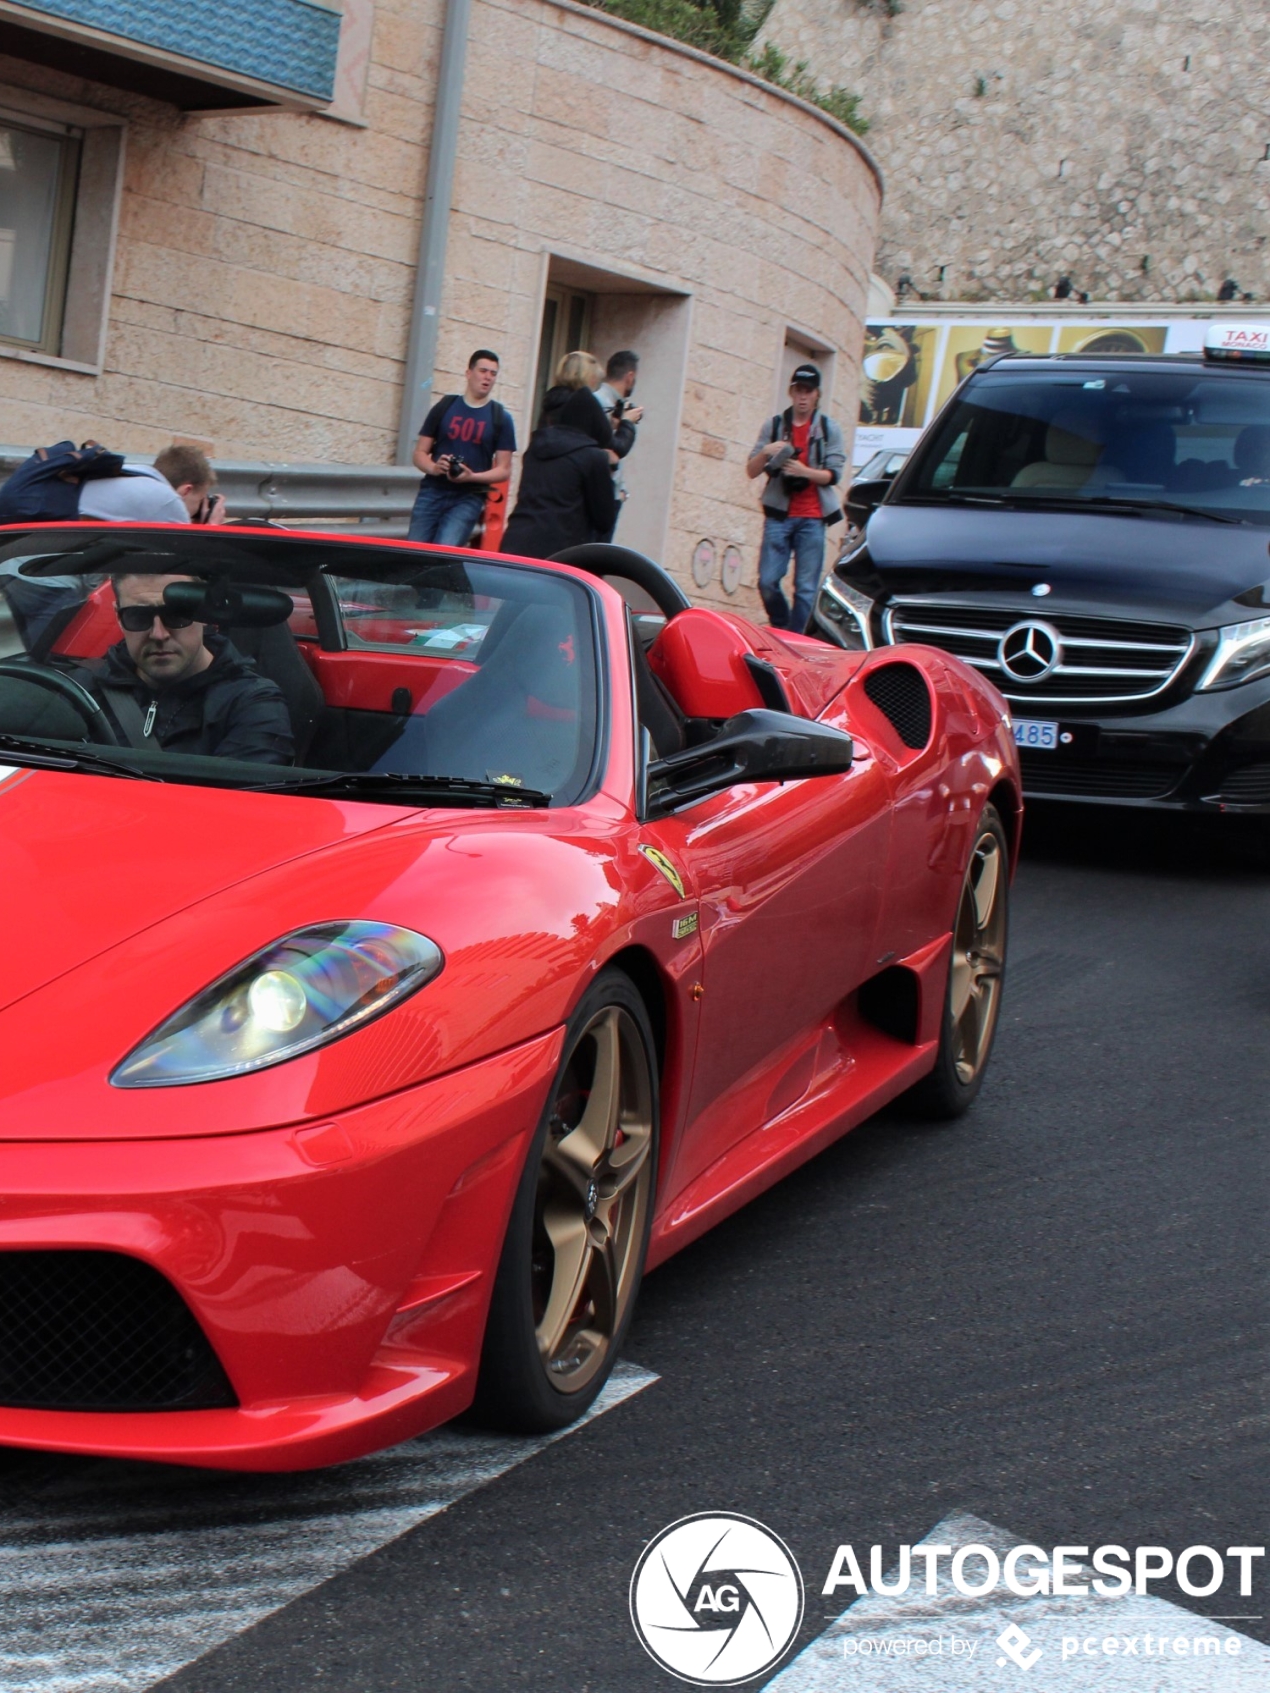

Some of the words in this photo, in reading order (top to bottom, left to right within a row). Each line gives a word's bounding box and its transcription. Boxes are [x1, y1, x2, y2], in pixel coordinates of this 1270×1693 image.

[1225, 330, 1268, 342] TAXI
[1221, 341, 1268, 350] MONACO
[447, 416, 486, 445] 501
[1015, 724, 1053, 745] 485
